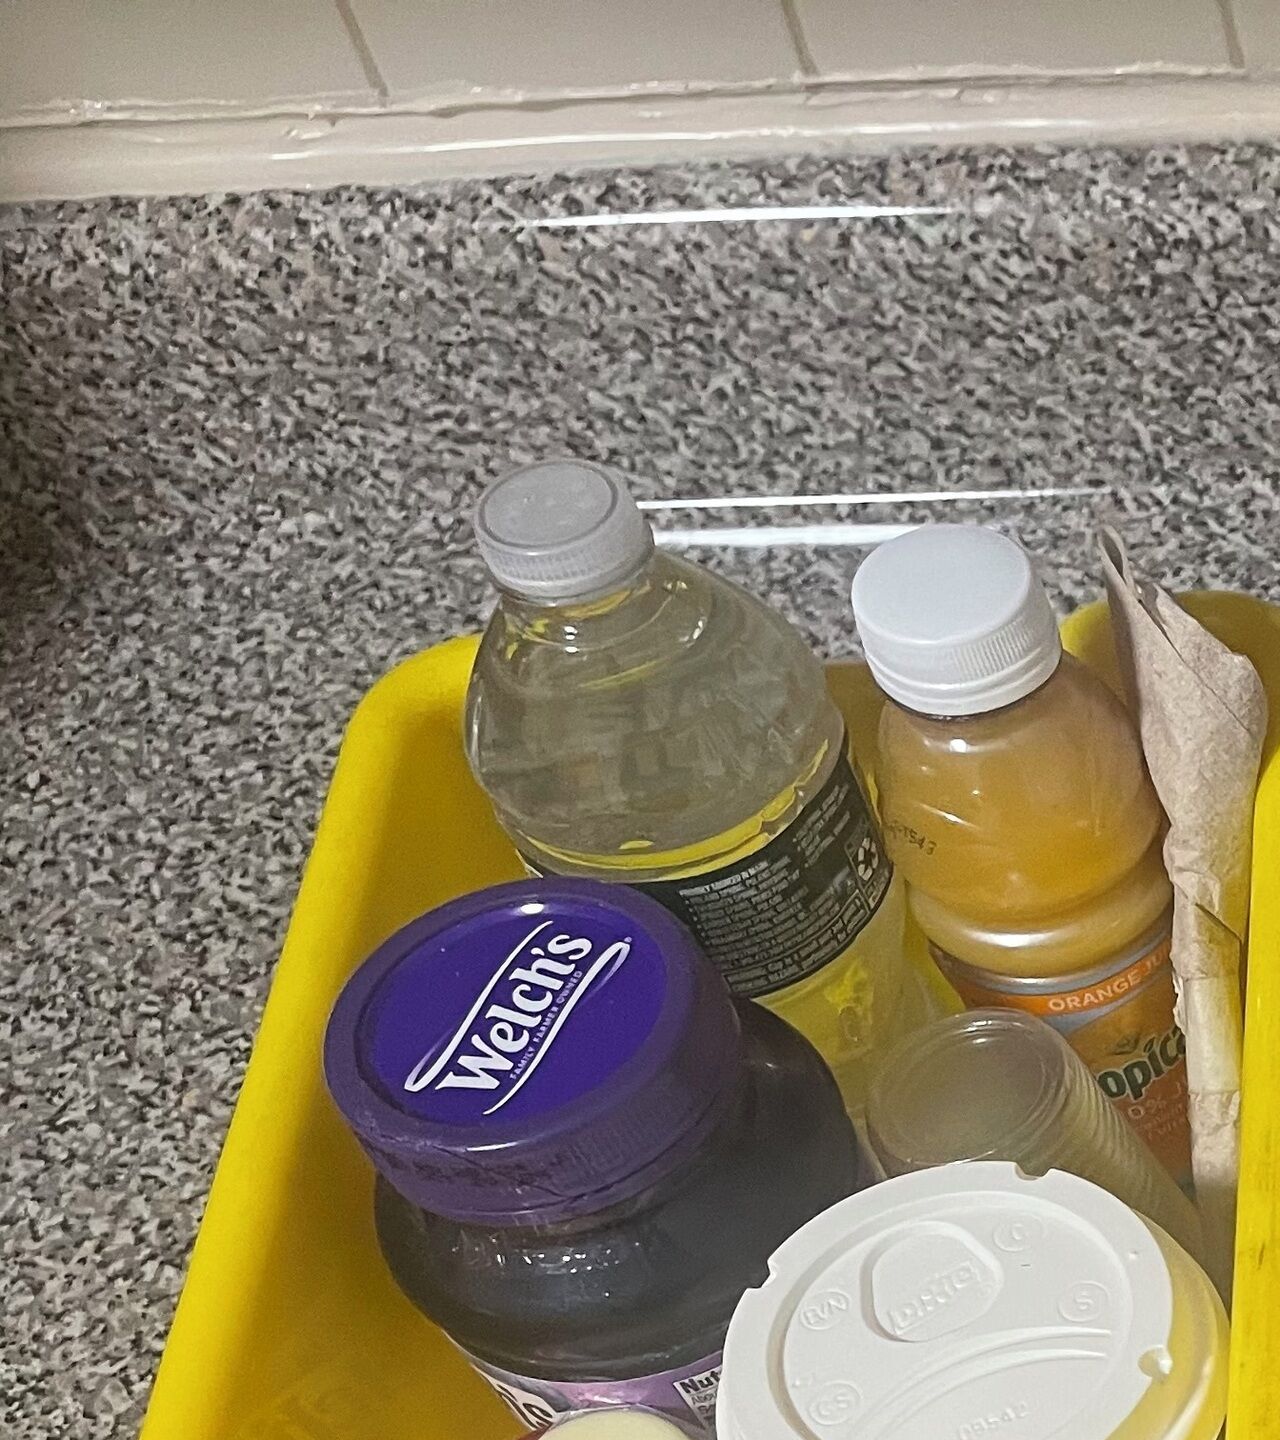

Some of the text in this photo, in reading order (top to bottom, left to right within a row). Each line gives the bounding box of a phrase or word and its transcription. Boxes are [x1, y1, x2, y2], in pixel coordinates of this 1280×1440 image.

[435, 934, 592, 1090] Welch's
[509, 970, 584, 1081] FAMILY FARMER OWNED
[1048, 968, 1141, 1011] ORANGE
